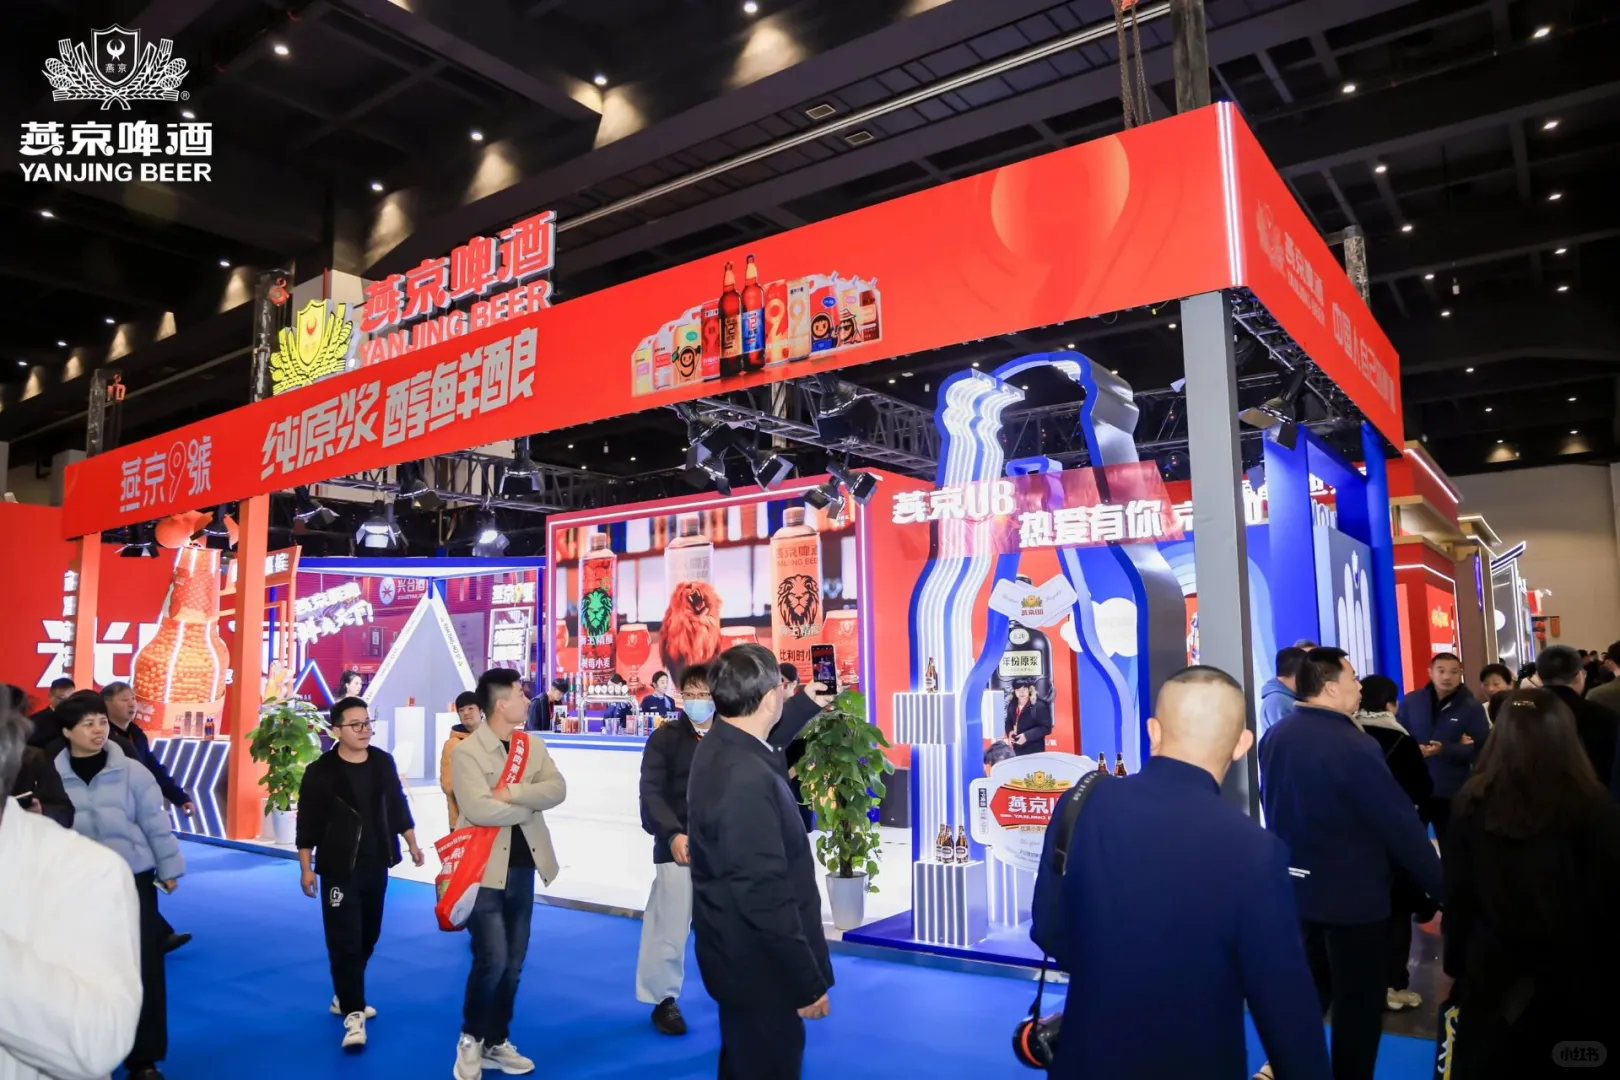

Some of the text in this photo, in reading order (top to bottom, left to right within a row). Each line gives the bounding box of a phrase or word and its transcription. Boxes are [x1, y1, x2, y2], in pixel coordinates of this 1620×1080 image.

[360, 210, 556, 333] 燕京啤酒
[359, 279, 554, 367] YANJING BEER
[260, 327, 538, 481] 纯原浆 醇鲜酿
[891, 480, 1164, 548] 燕京U8 热爱有你
[780, 649, 811, 661] 比利时小
[1003, 656, 1038, 666] 年份原浆
